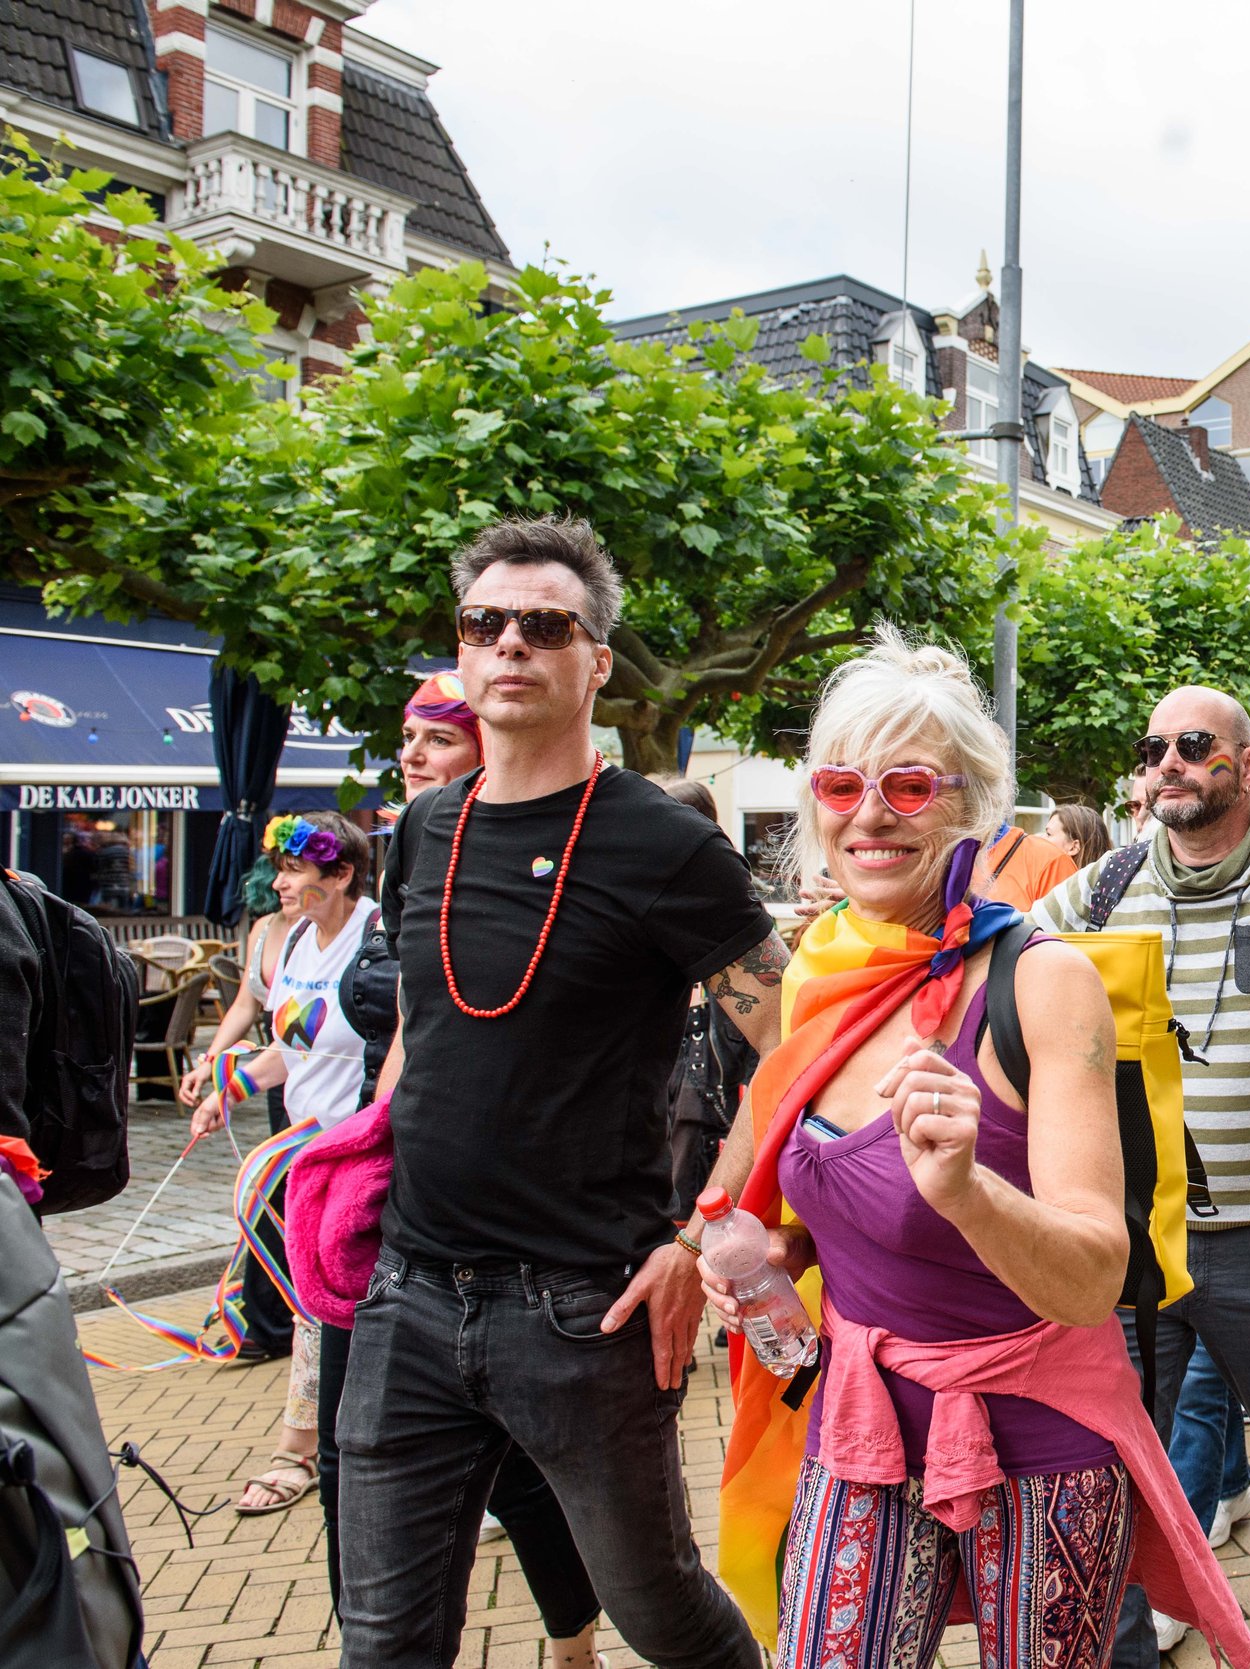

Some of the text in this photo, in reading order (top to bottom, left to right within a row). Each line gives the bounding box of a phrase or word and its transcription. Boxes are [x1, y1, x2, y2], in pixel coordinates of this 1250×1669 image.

[19, 785, 200, 809] DE KALE JONKER
